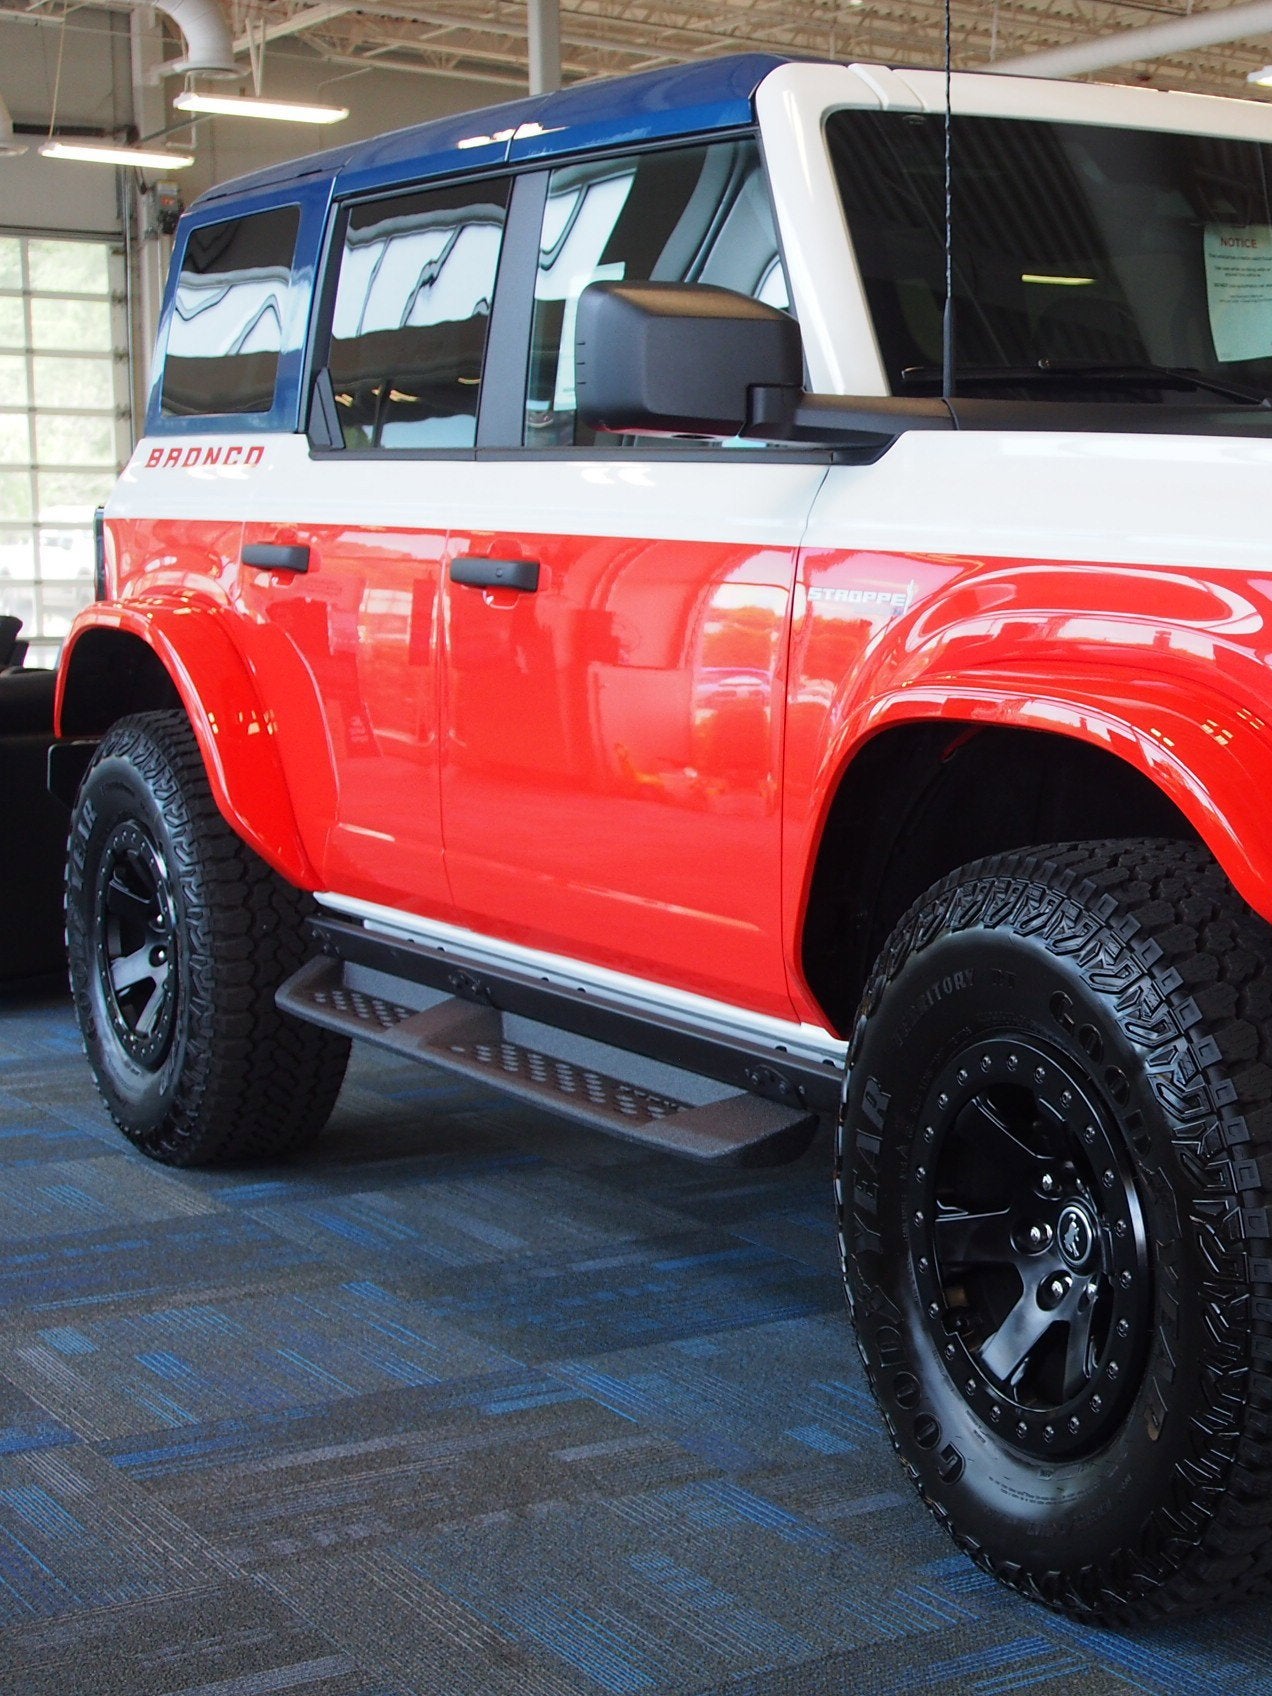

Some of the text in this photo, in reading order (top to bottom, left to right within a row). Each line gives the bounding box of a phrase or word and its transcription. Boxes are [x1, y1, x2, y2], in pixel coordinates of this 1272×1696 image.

[1220, 237, 1258, 249] NOTICE
[145, 446, 265, 468] BRONCO
[807, 586, 907, 607] STROPPE
